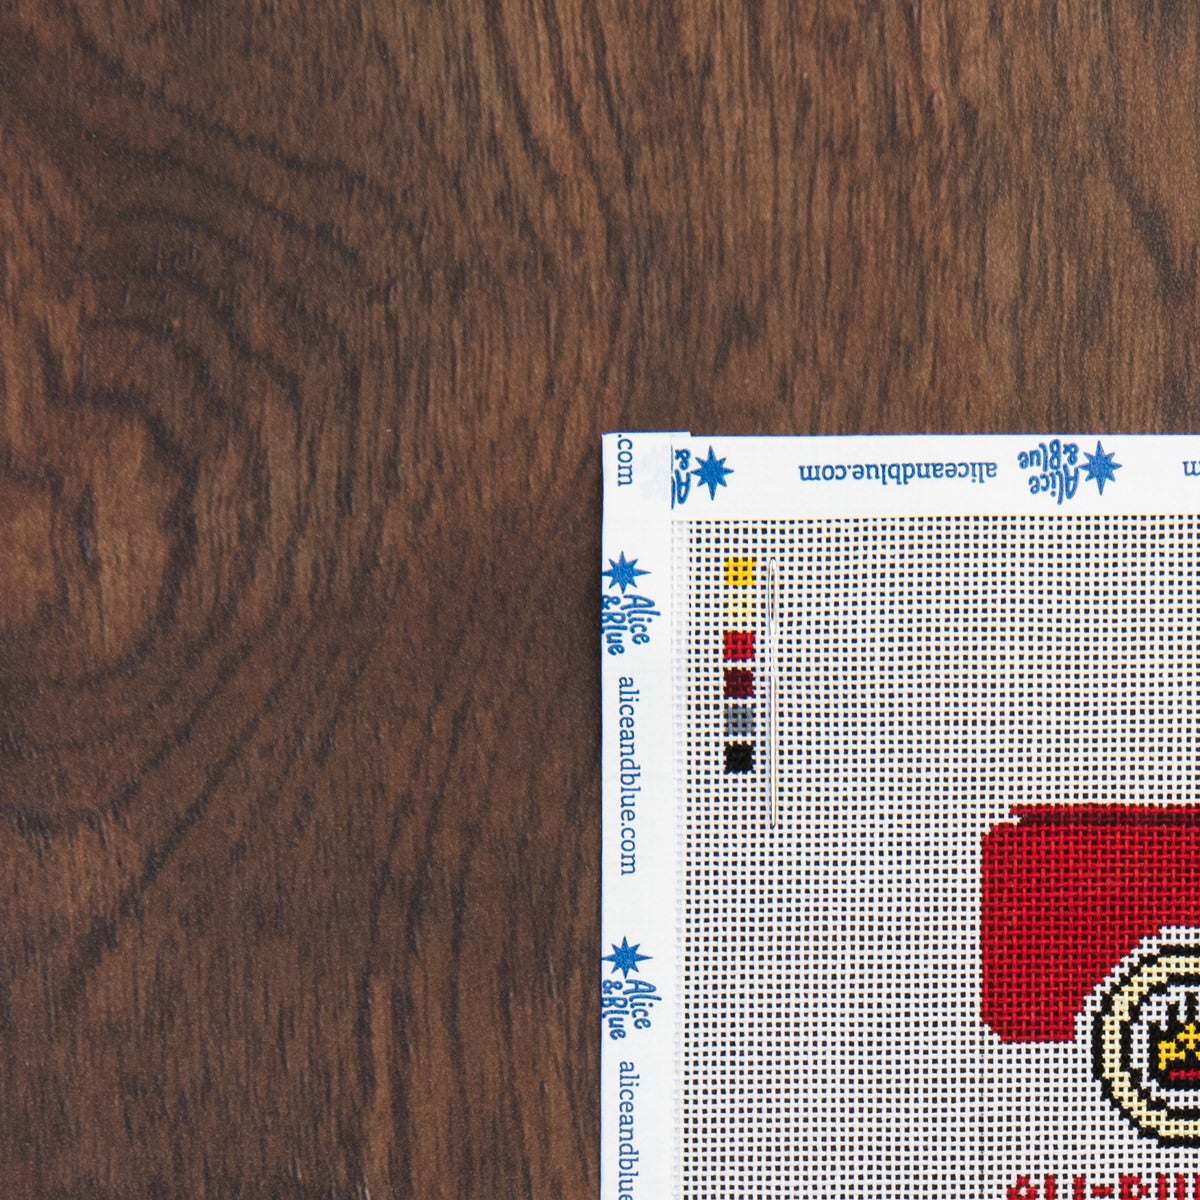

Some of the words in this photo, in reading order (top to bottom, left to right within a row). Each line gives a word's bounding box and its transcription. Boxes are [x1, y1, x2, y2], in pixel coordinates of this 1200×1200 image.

[799, 462, 998, 486] aliceandblue.com
[1028, 464, 1080, 504] Alice
[620, 593, 661, 645] Alice
[619, 676, 641, 876] aliceandblue.com
[625, 978, 662, 1030] Alice
